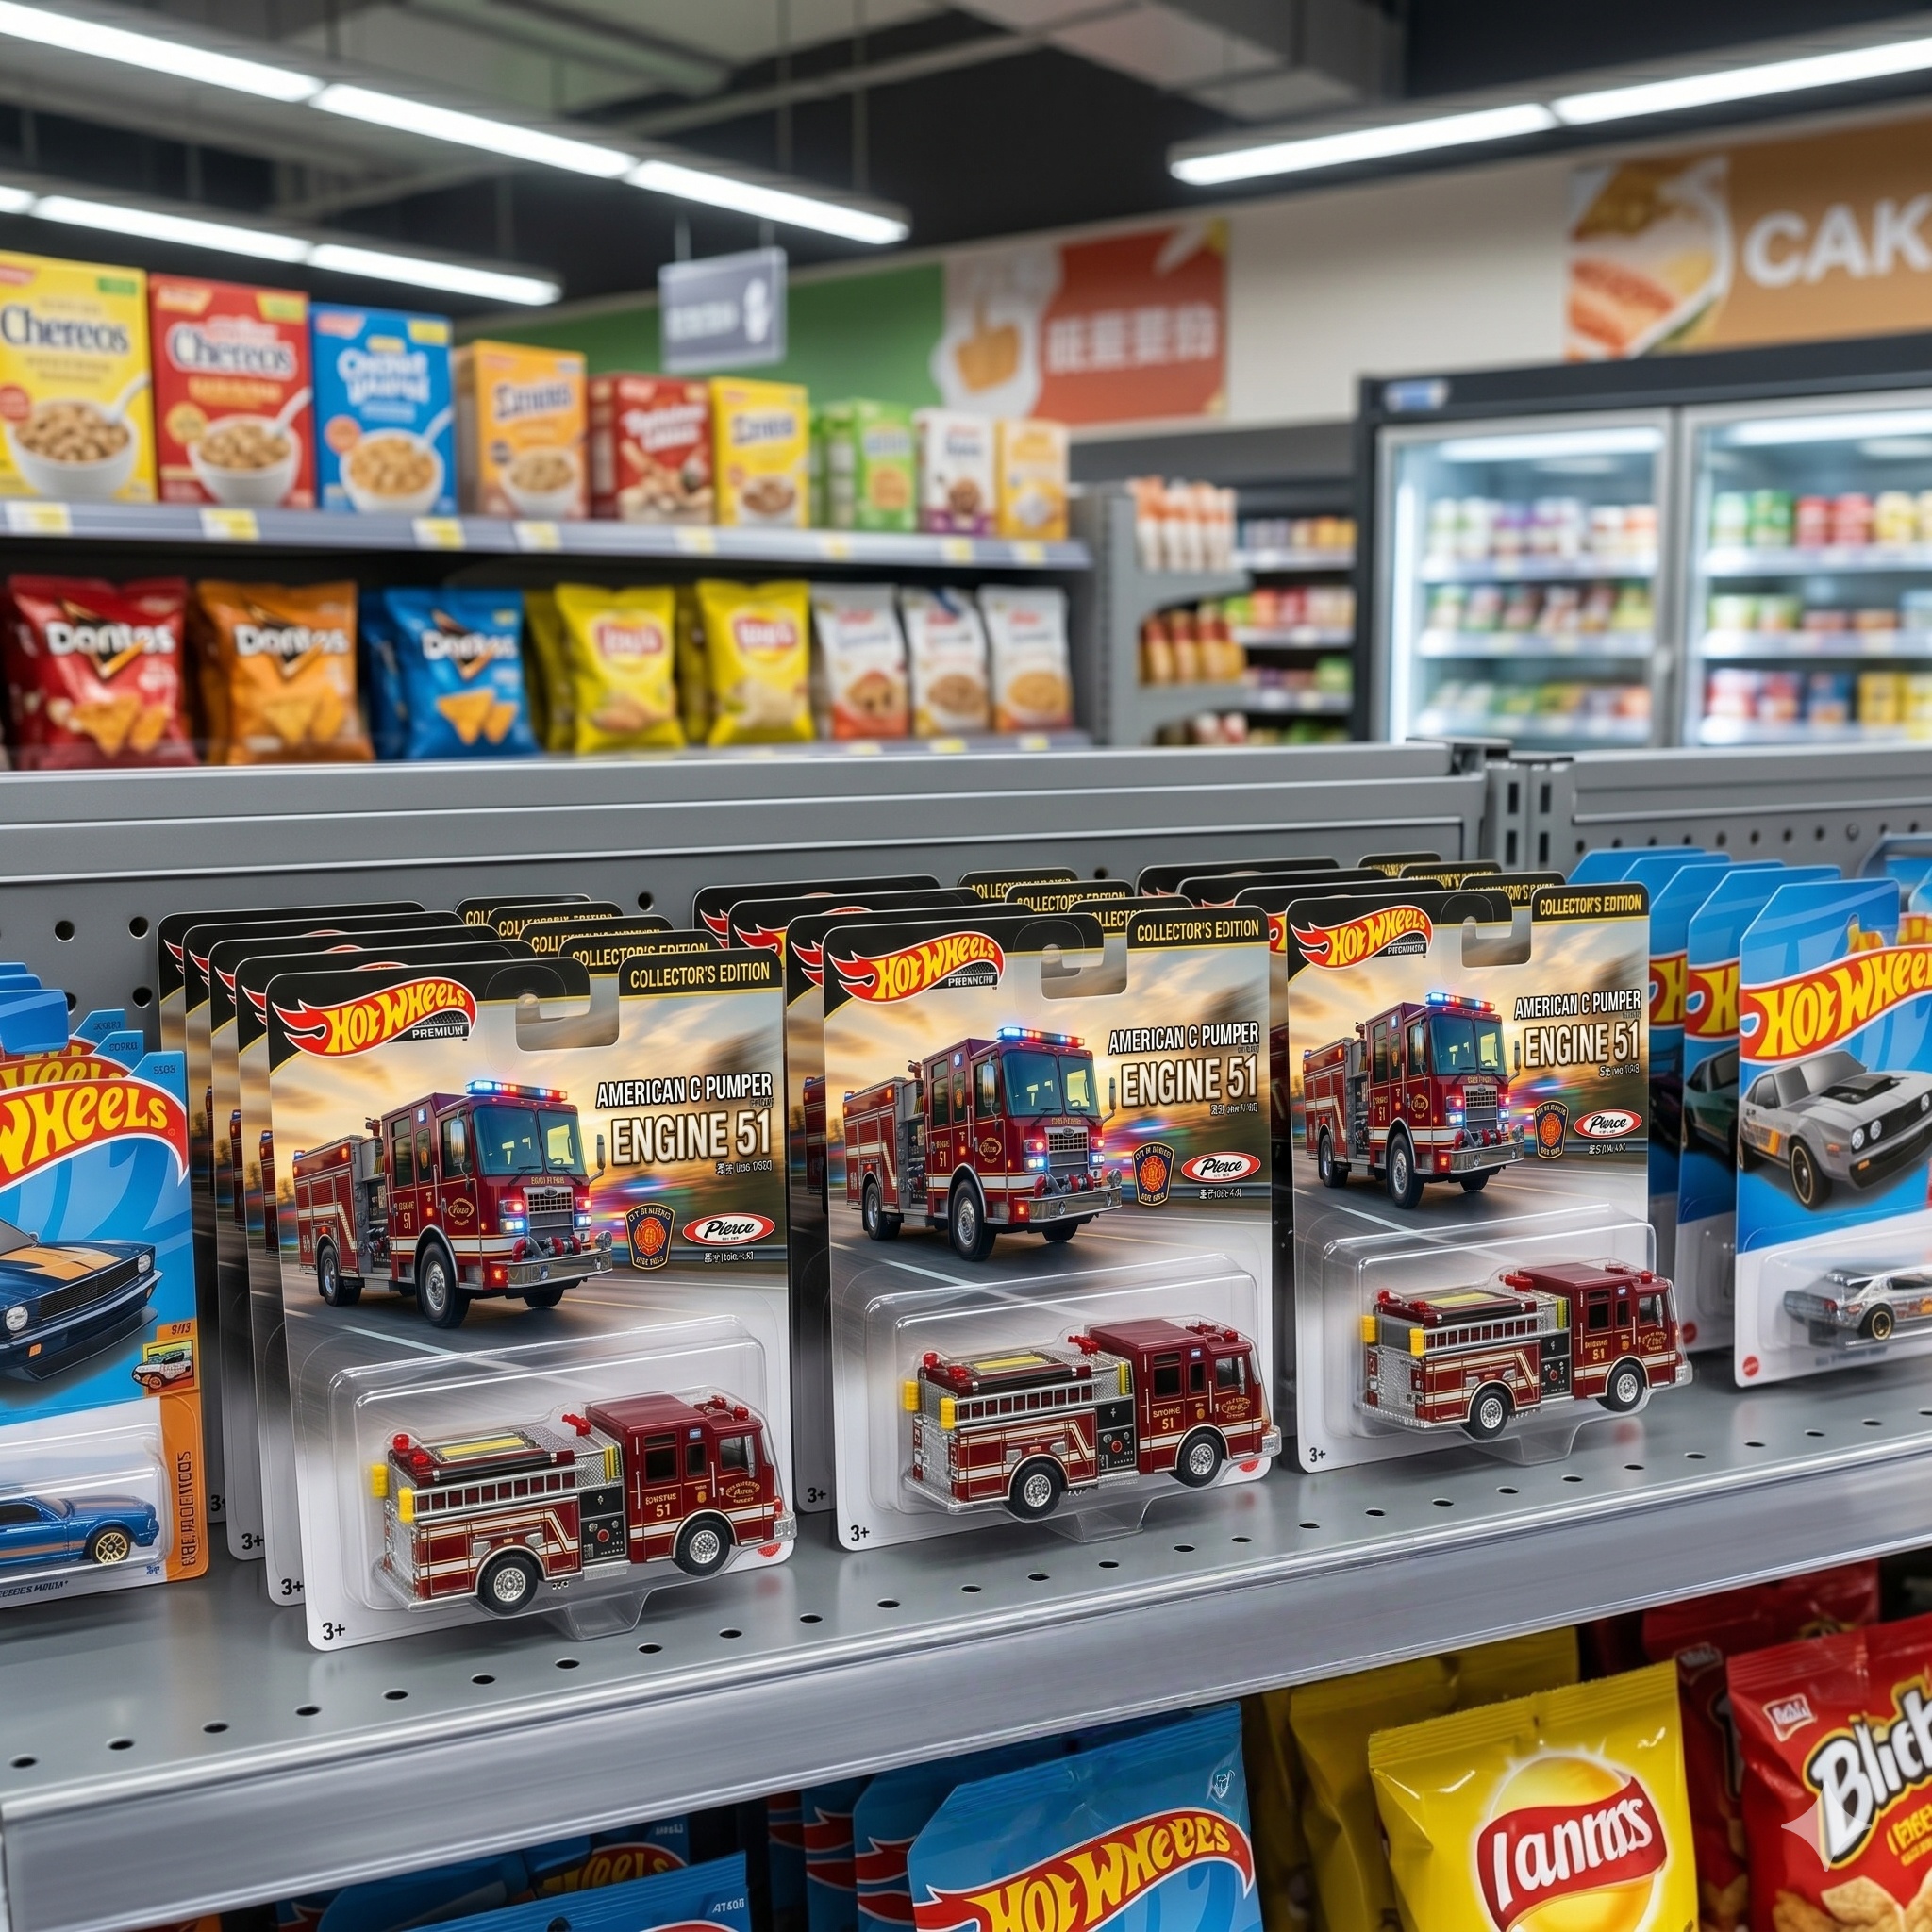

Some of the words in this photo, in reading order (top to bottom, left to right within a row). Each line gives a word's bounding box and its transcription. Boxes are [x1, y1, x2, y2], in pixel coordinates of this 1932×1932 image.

[1745, 192, 1932, 288] CAK
[1540, 897, 1602, 916] COLLECTOR'S
[1604, 894, 1642, 912] EDITION
[1138, 922, 1212, 942] COLLECTOR'S
[1215, 919, 1260, 938] EDITION
[630, 964, 716, 989] COLLECTOR'S
[720, 961, 771, 983] EDITION
[1514, 994, 1578, 1020] AMERICAN
[1581, 992, 1591, 1015] C
[1592, 990, 1641, 1013] PUMPER
[1108, 1026, 1184, 1054] AMERICAN
[1189, 1024, 1198, 1048] C
[1202, 1022, 1259, 1047] PUMPER
[1525, 1023, 1608, 1068] ENGINE
[1614, 1020, 1640, 1061] 51
[596, 1076, 685, 1108] AMERICAN
[690, 1075, 702, 1102] C
[706, 1073, 773, 1100] PUMPER
[1122, 1058, 1222, 1107] ENGINE
[1227, 1054, 1257, 1098] 51
[612, 1111, 729, 1165] ENGINE
[736, 1108, 771, 1156] 51
[1162, 1417, 1174, 1430] 51
[1309, 1446, 1326, 1463] 3+
[807, 1487, 827, 1503] 3+
[656, 1503, 671, 1518] 51
[242, 1533, 264, 1550] 3+
[850, 1524, 870, 1541] 3+
[281, 1578, 304, 1595] 3+
[322, 1622, 346, 1641] 3+
